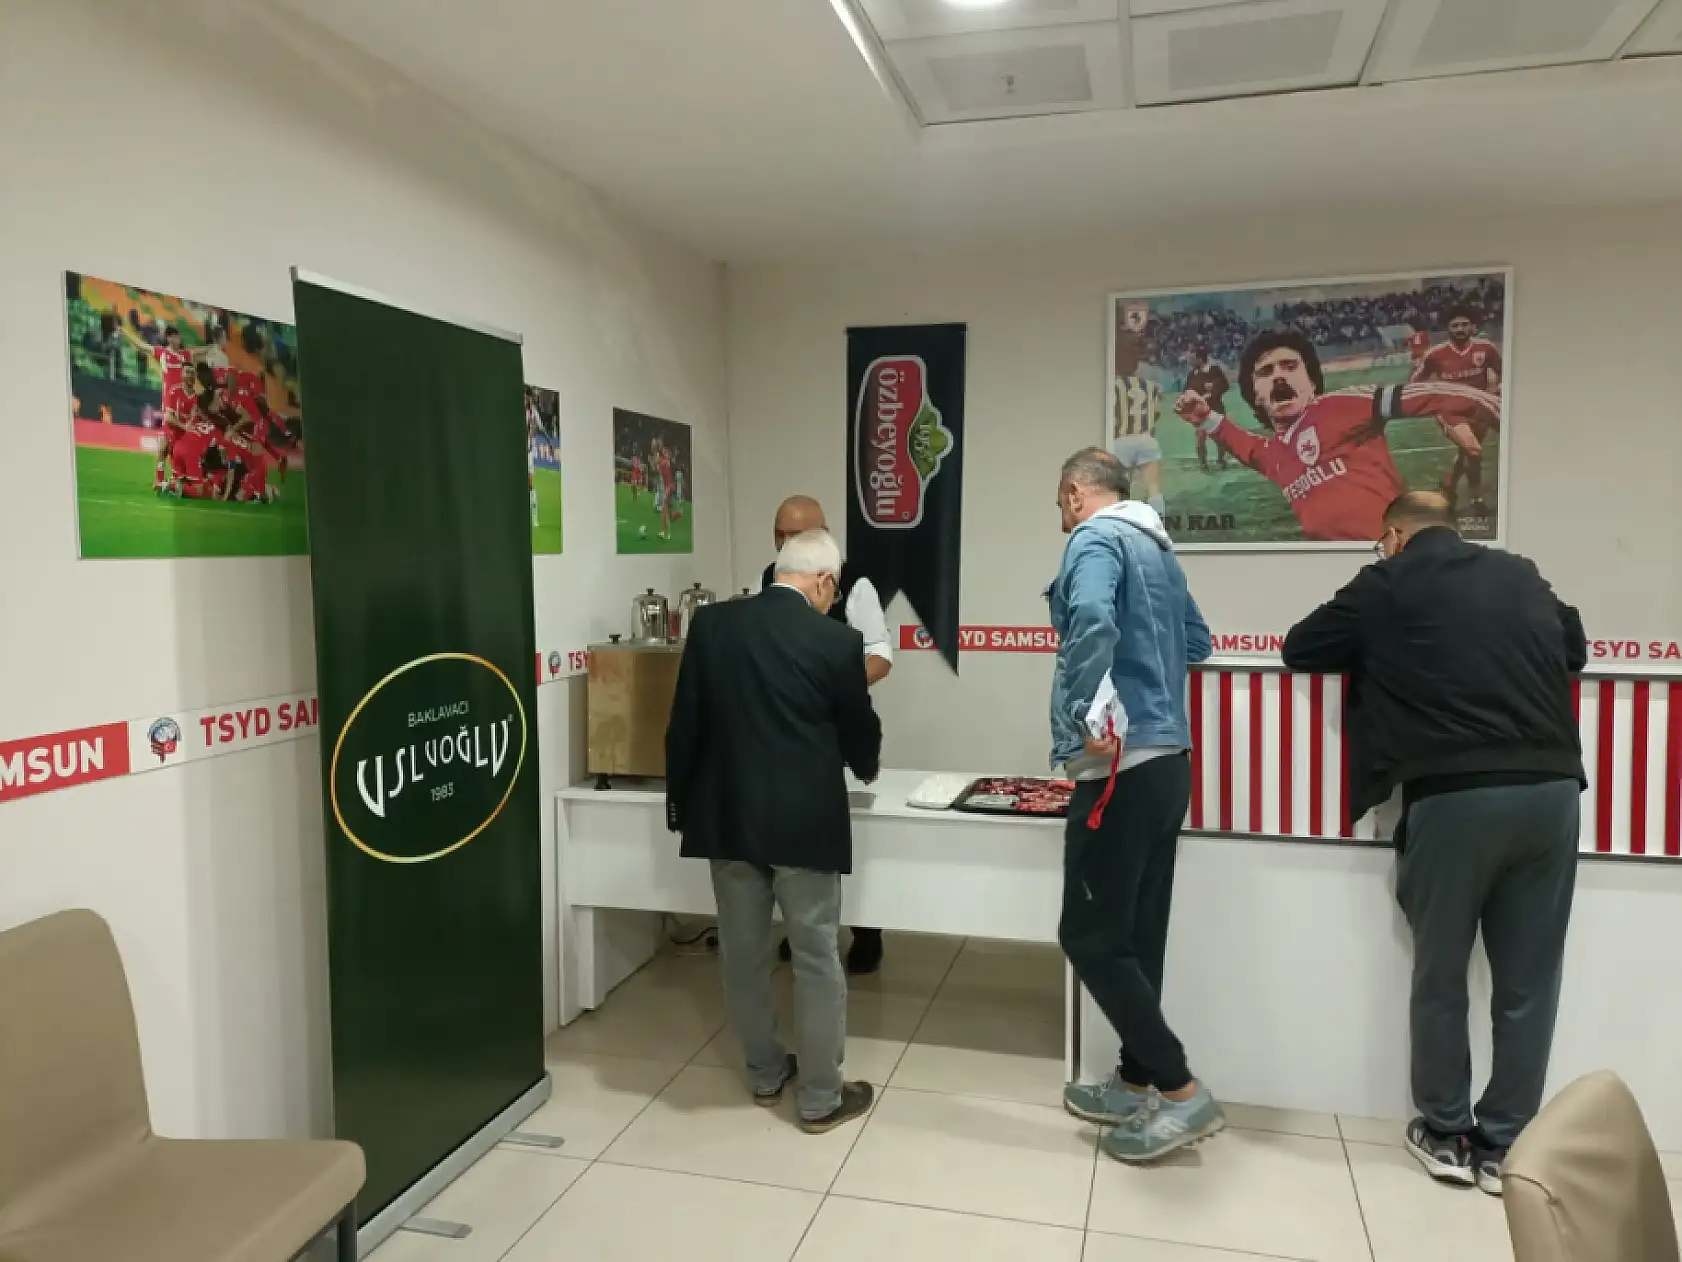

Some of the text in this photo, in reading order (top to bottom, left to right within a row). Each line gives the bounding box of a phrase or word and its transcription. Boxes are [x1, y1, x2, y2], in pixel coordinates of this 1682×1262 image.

[870, 368, 904, 516] özbeyoğlu
[1187, 513, 1235, 531] KAR
[959, 631, 986, 646] YD
[408, 701, 469, 728] BAKLAVACI
[200, 707, 271, 747] TSYD
[430, 782, 454, 803] 1983
